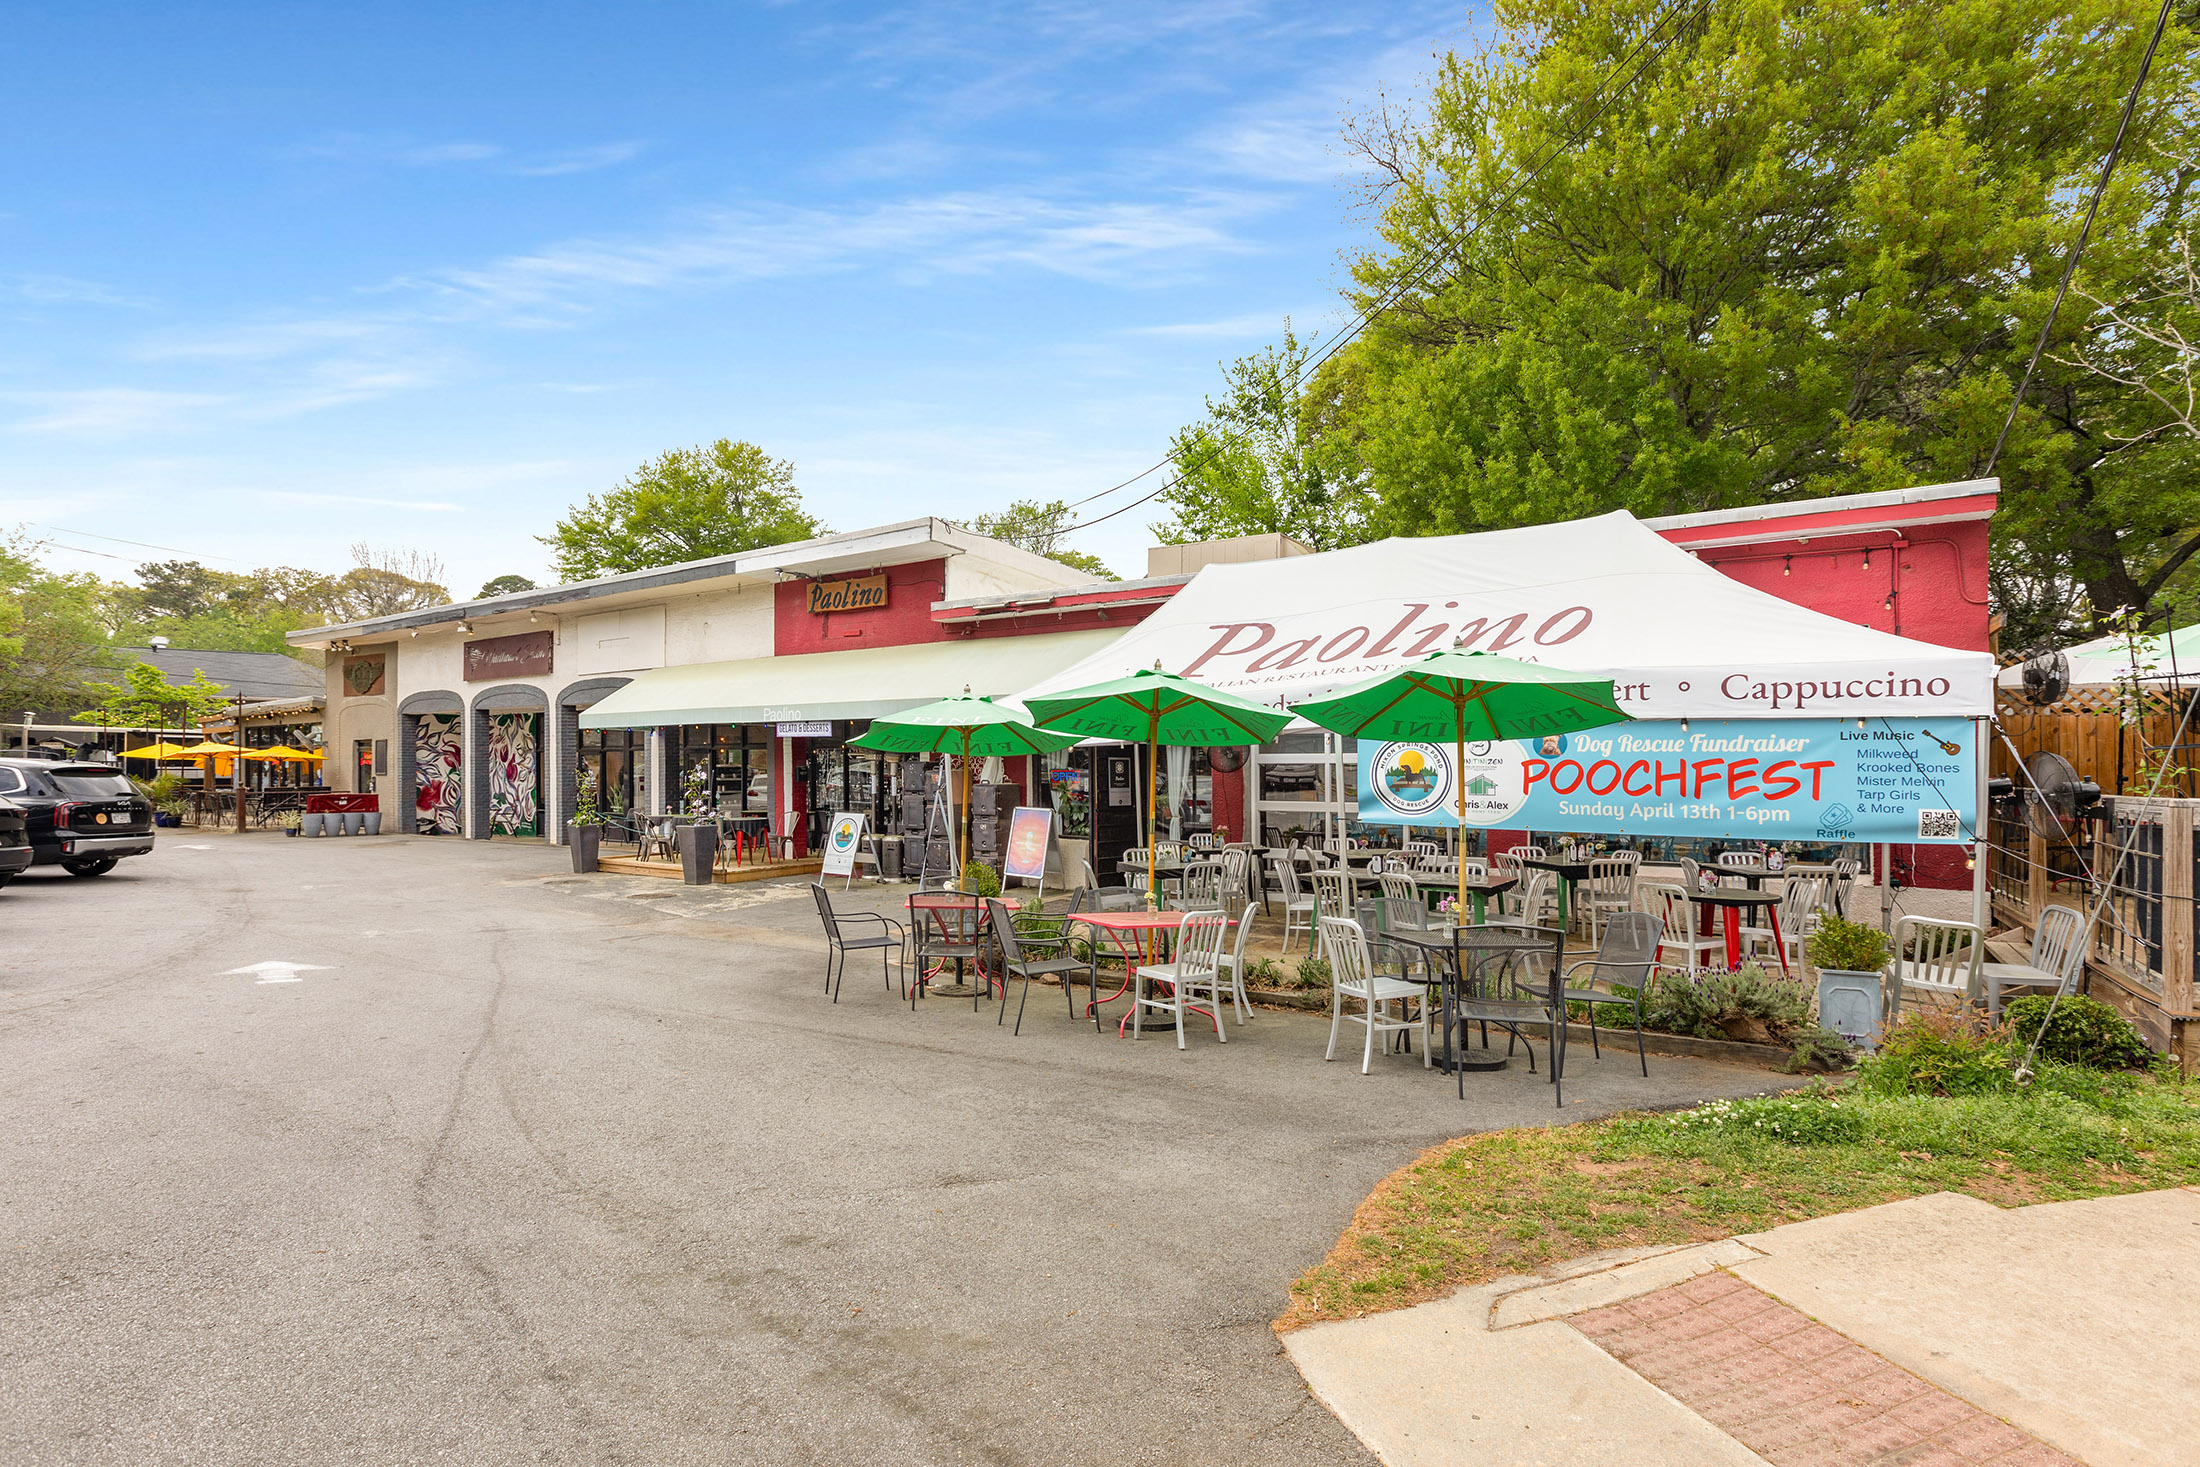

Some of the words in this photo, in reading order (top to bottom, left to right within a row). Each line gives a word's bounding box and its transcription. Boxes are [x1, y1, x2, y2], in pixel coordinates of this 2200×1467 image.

[809, 581, 883, 613] Paolino
[1178, 601, 1593, 677] Paolino
[1264, 664, 1396, 682] RESTAURANT
[1721, 671, 1950, 709] Cappuccino
[763, 706, 802, 721] Paolino
[779, 723, 798, 733] GELATO
[803, 722, 829, 733] DESSERTS
[1840, 731, 1869, 741] Live
[1873, 731, 1915, 741] Music
[1574, 734, 1613, 758] Dog
[1618, 734, 1685, 753] Rescue
[1690, 733, 1810, 753] Fundraiser
[1397, 742, 1428, 751] SPRINGS
[1429, 750, 1443, 769] POND
[1857, 749, 1919, 759] Milkweed
[1857, 763, 1912, 773] Krooked
[1917, 763, 1960, 773] Bones
[1052, 771, 1079, 782] OPEN
[1521, 758, 1835, 801] POOCHFEST
[1857, 776, 1897, 786] Mister
[1901, 776, 1945, 787] Melvin
[1857, 790, 1886, 801] Tarp
[1889, 790, 1921, 801] Girls
[1406, 799, 1430, 807] RESCUE
[1857, 803, 1867, 813] &
[1871, 803, 1905, 814] More
[1559, 801, 1625, 820] Sunday
[1630, 803, 1675, 821] April
[1680, 803, 1721, 820] 13th
[1727, 805, 1790, 824] 1-6pm
[1816, 829, 1856, 839] Raffle
